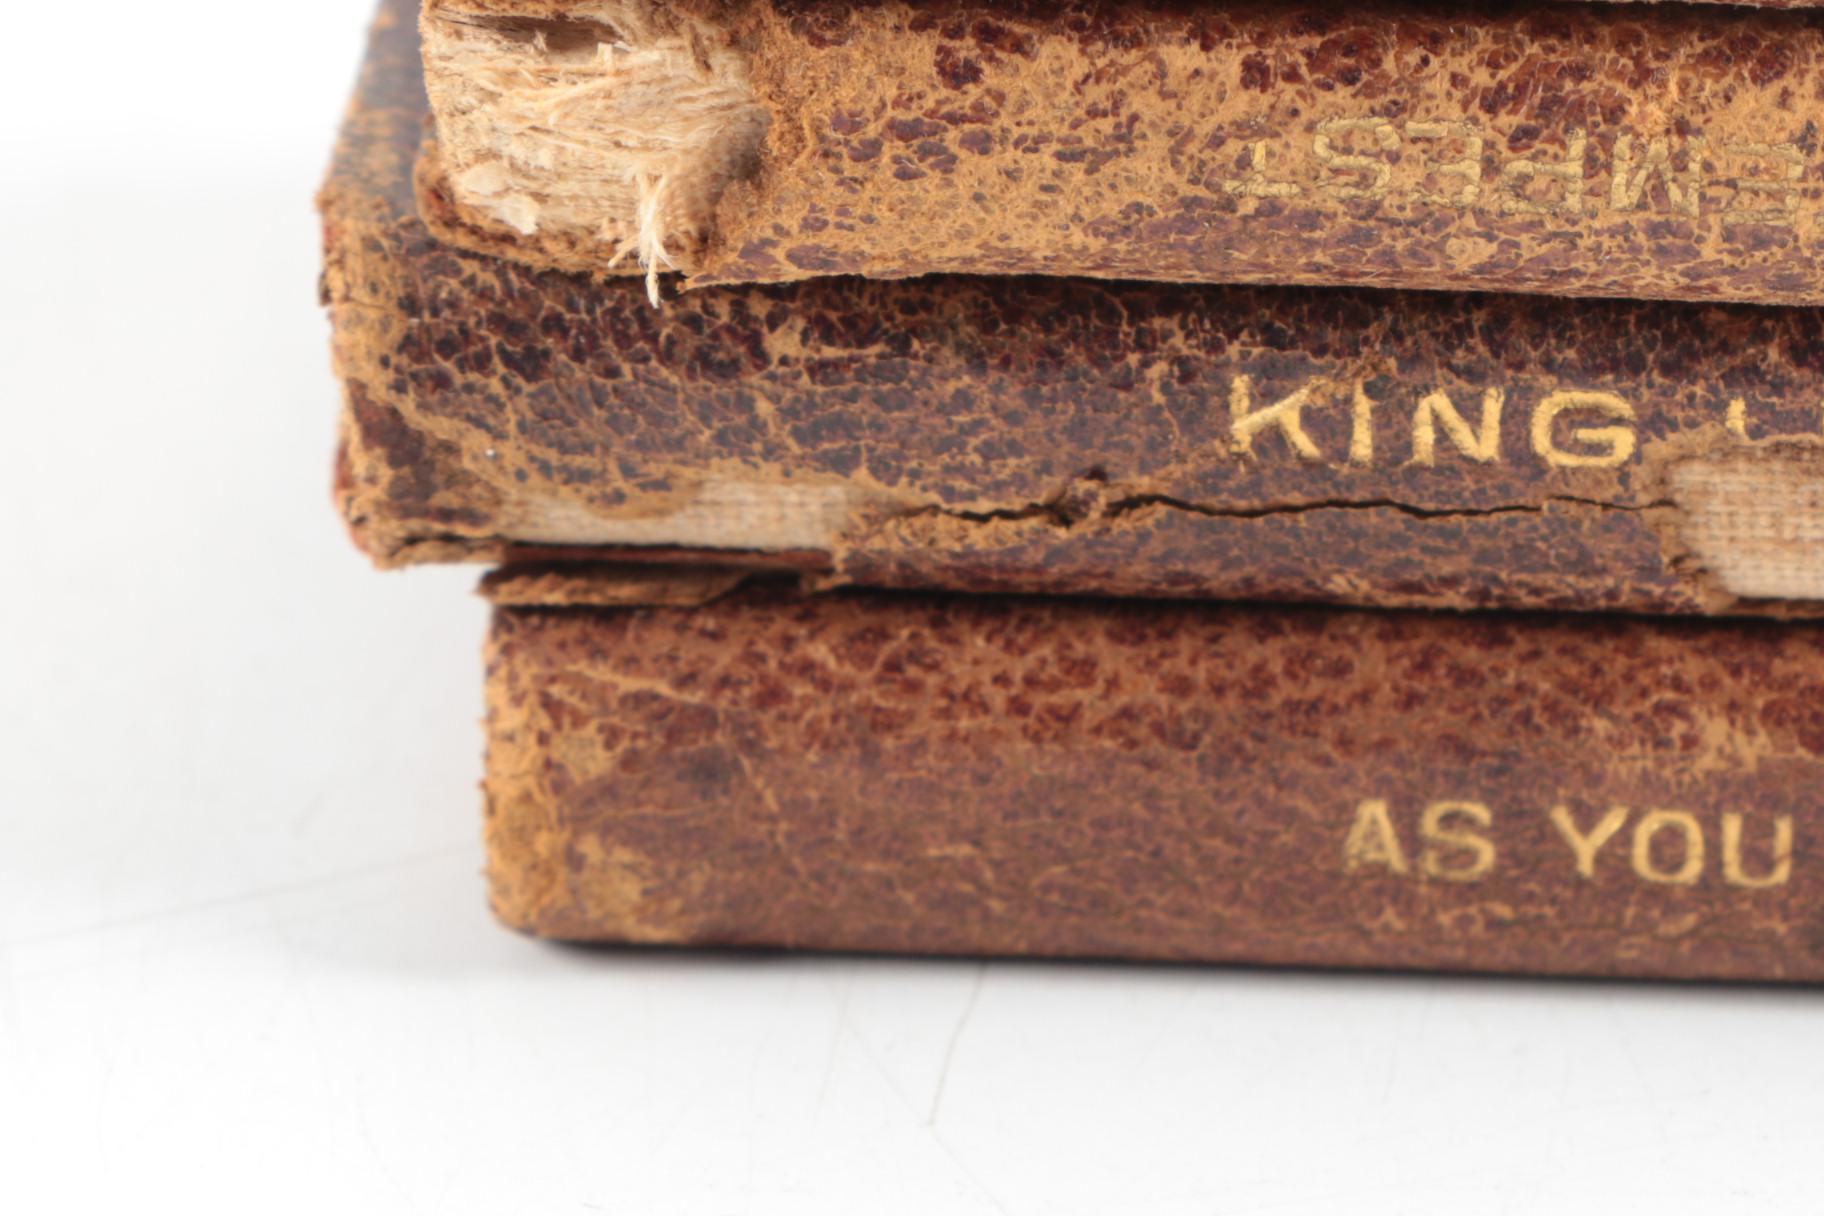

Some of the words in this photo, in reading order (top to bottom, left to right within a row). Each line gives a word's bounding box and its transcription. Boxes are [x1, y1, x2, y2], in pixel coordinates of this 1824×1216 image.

[1226, 373, 1638, 469] KING
[1342, 798, 1497, 884] AS
[1548, 804, 1793, 888] YOU
